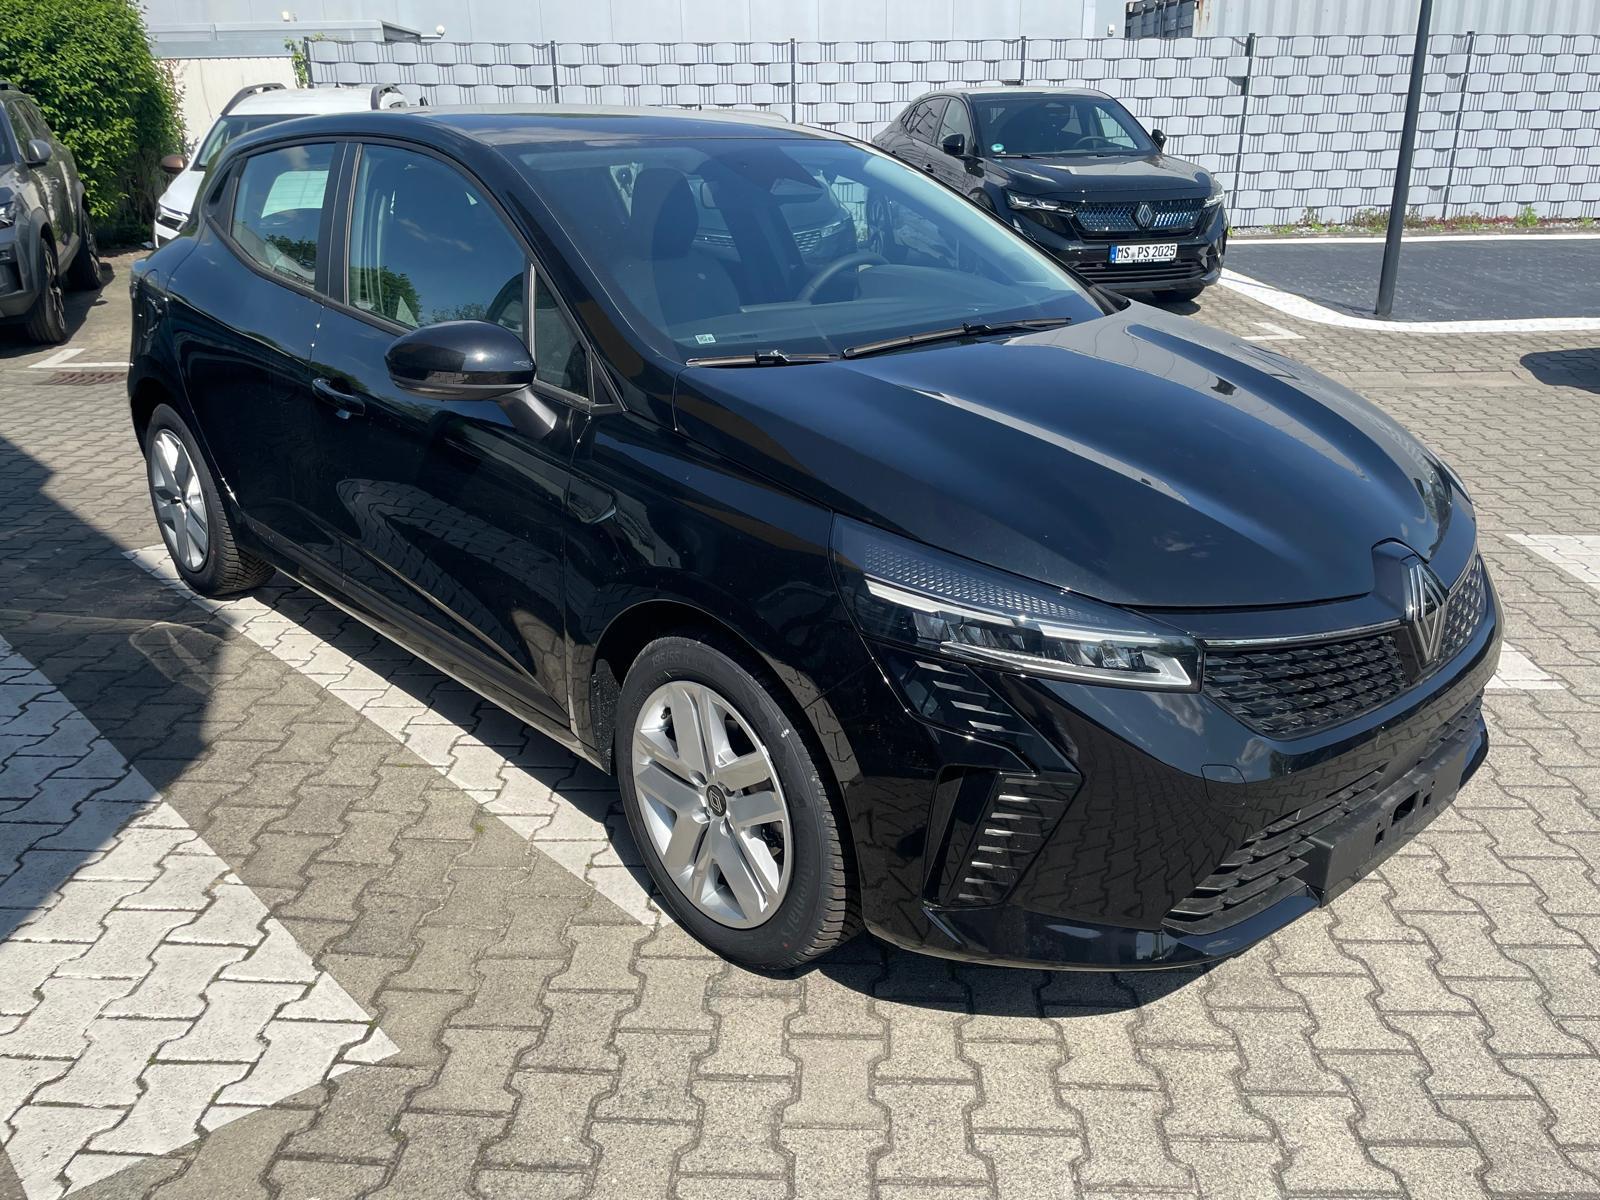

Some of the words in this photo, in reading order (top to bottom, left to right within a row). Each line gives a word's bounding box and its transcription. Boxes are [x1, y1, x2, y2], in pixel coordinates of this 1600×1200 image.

[1117, 247, 1130, 259] MS
[1137, 246, 1150, 258] PS
[1152, 245, 1176, 257] 2025
